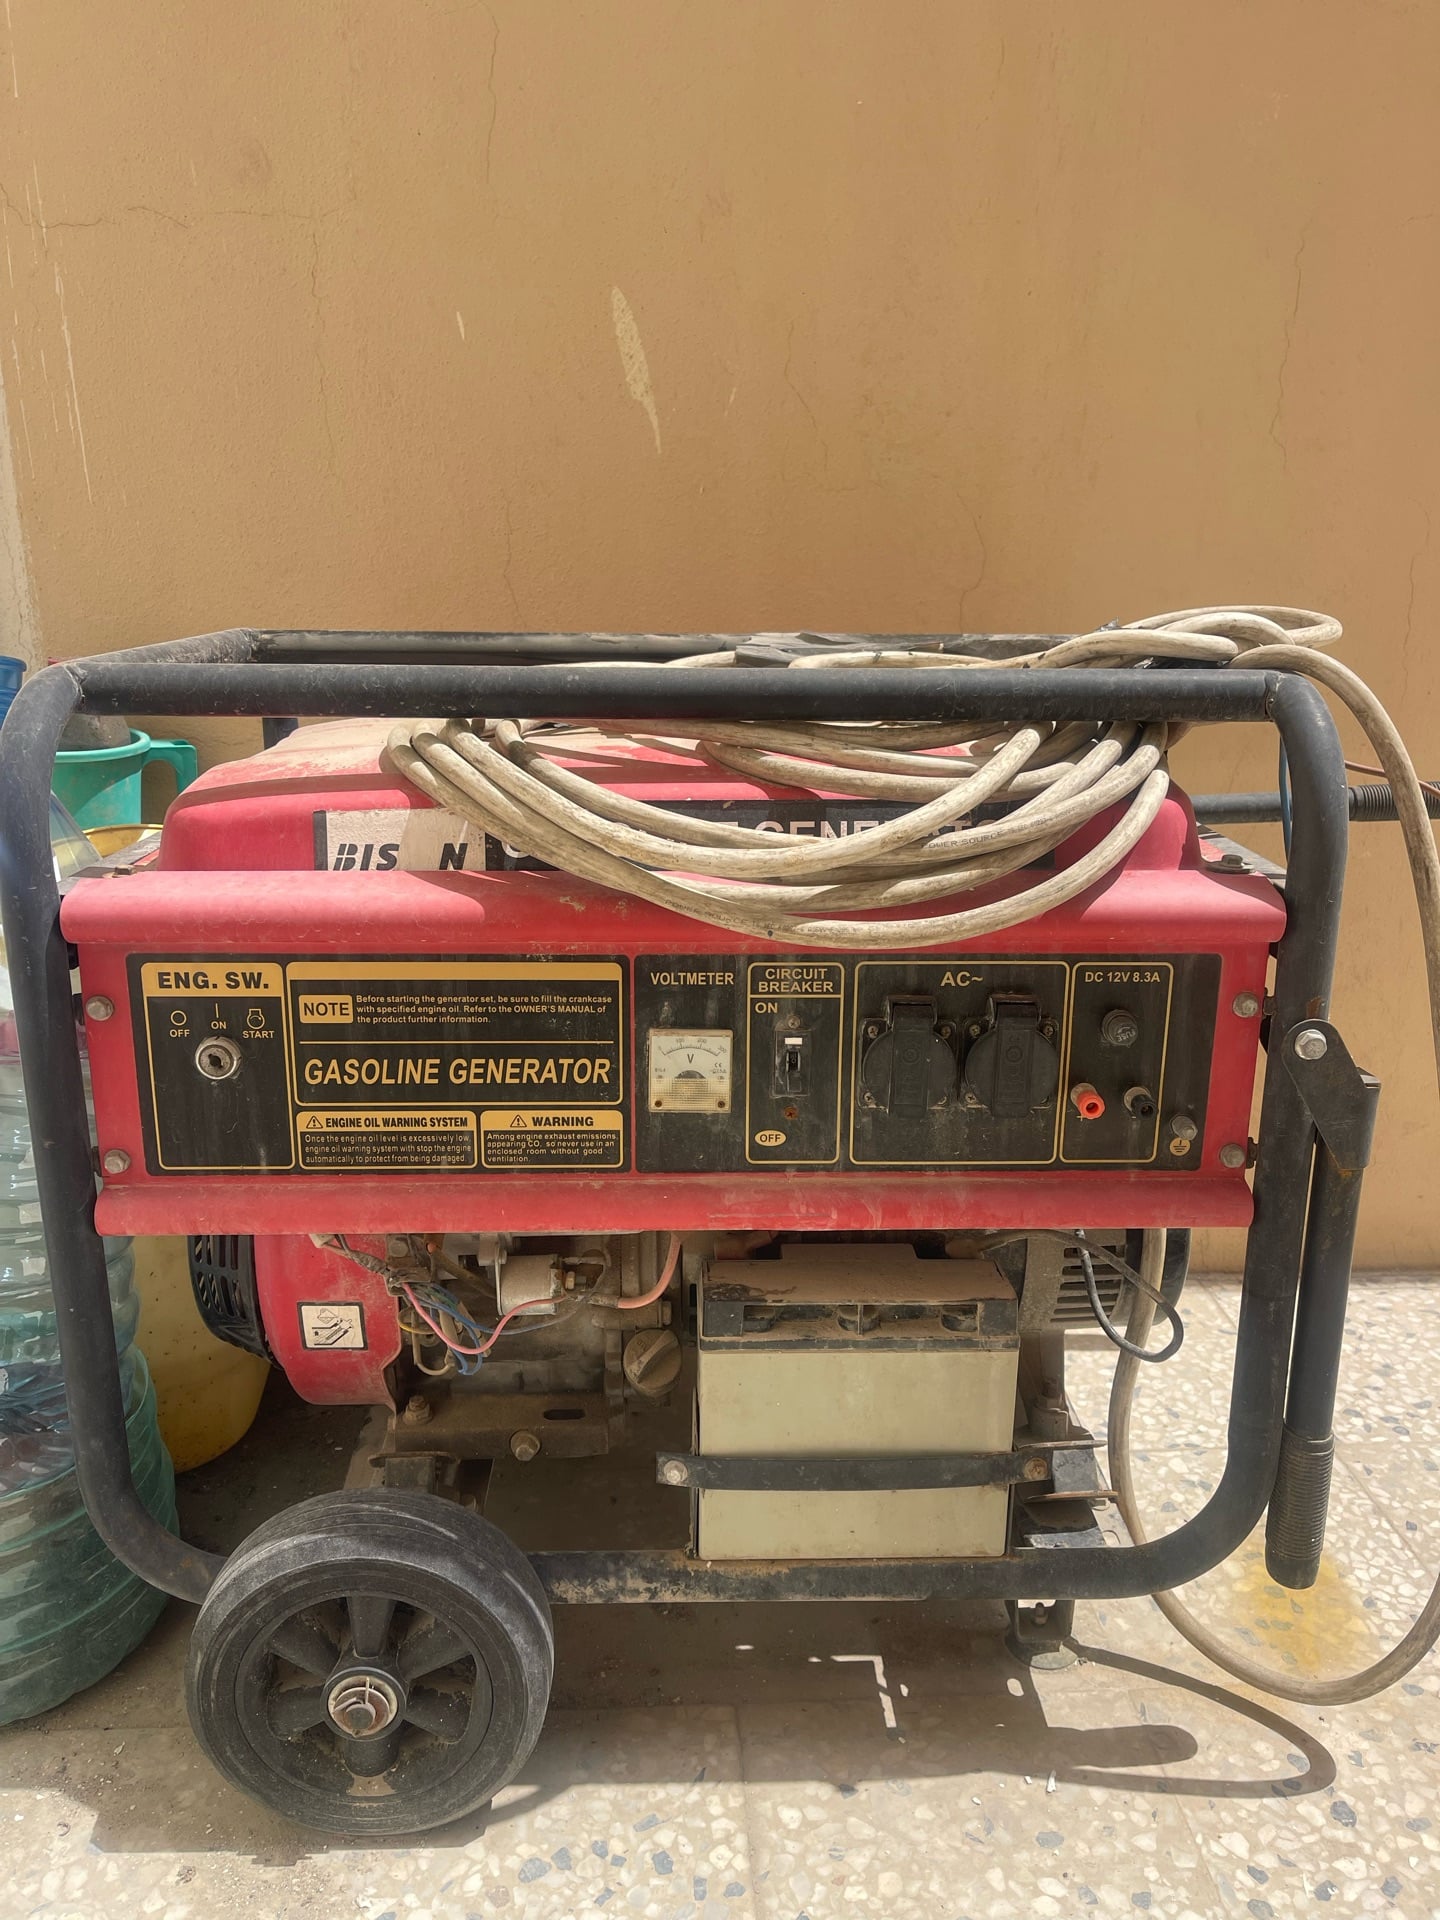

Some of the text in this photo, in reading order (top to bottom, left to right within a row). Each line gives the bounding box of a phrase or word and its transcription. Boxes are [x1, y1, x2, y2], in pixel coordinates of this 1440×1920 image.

[651, 972, 735, 985] VOLTMETER
[765, 968, 828, 979] CIRCUIT
[1085, 971, 1161, 983] DC 12V 8.3A
[158, 971, 269, 989] ENG. SW.
[758, 981, 834, 993] BREAKER
[356, 995, 385, 1003] Before
[386, 995, 420, 1004] starting
[421, 995, 436, 1003] the
[437, 996, 478, 1005] generator
[498, 995, 509, 1003] be
[530, 995, 540, 1003] to
[541, 995, 552, 1003] fill
[553, 995, 567, 1003] the
[568, 995, 612, 1003] crankcase
[303, 1002, 350, 1016] NOTE
[356, 1005, 375, 1013] with
[377, 1005, 416, 1015] specified
[417, 1006, 446, 1015] engine
[463, 1005, 487, 1013] Refer
[488, 1005, 497, 1013] to
[499, 1005, 512, 1013] the
[513, 1005, 556, 1013] OWNER'S
[557, 1005, 596, 1013] MANUAL
[597, 1005, 606, 1013] of
[754, 1002, 778, 1013] ON
[211, 1021, 227, 1030] ON
[372, 1016, 406, 1025] product
[169, 1029, 190, 1038] OFF
[242, 1030, 275, 1039] START
[687, 1053, 694, 1064] V
[303, 1057, 612, 1085] GASOLINE GENERATOR
[325, 1117, 468, 1128] ENGINE OIL WARNING SYSTEM
[532, 1116, 594, 1127] WARNING
[305, 1134, 325, 1142] Once
[326, 1134, 339, 1142] the
[340, 1135, 367, 1144] engine
[368, 1134, 378, 1142] oil
[380, 1134, 398, 1142] level
[400, 1134, 407, 1142] is
[408, 1134, 454, 1143] excessively
[487, 1133, 515, 1141] Among
[760, 1133, 781, 1143] OFF
[305, 1144, 471, 1154] engine oil warning system with stop the engine
[487, 1140, 526, 1148] appearing
[583, 1148, 603, 1156] good
[305, 1155, 354, 1164] automatically
[364, 1155, 390, 1164] protect
[391, 1154, 409, 1162] from
[410, 1154, 431, 1164] being
